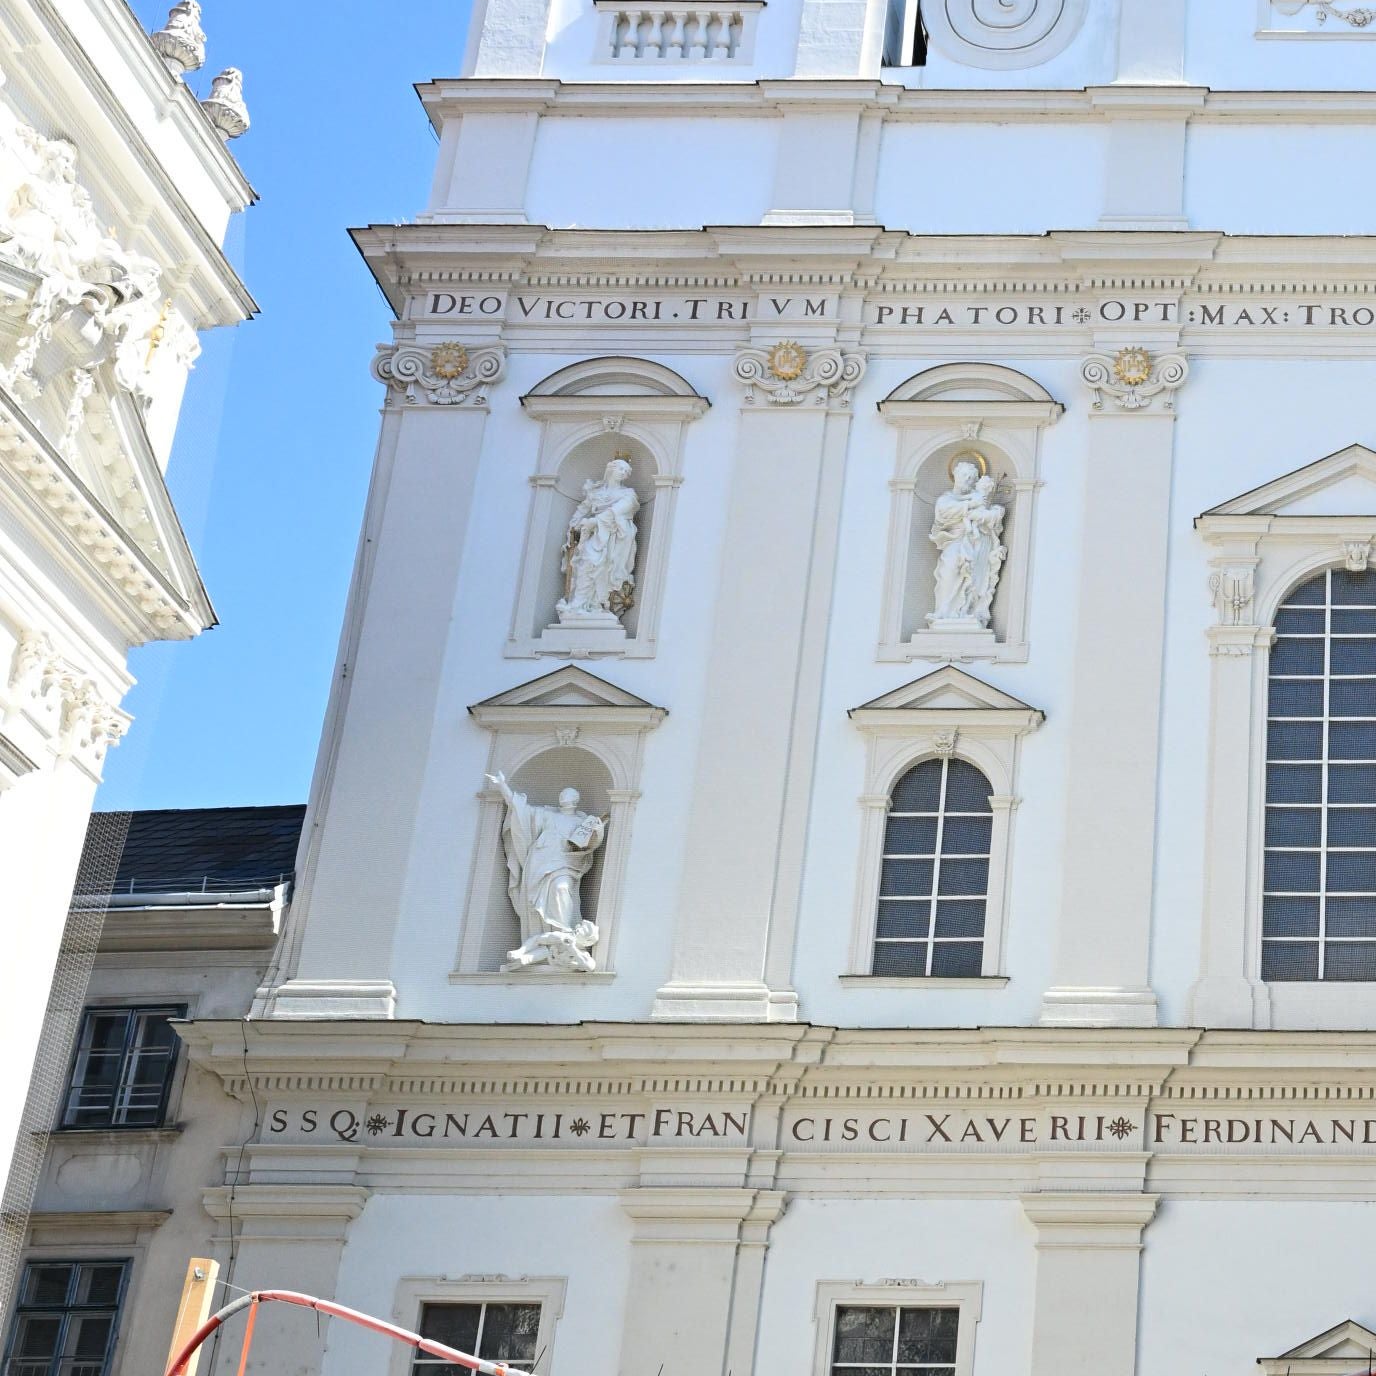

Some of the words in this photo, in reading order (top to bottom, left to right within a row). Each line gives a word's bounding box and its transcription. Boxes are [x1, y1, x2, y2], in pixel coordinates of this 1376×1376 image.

[429, 293, 502, 314] DEO
[391, 1109, 563, 1139] IGNATII
[597, 1112, 646, 1139] ET
